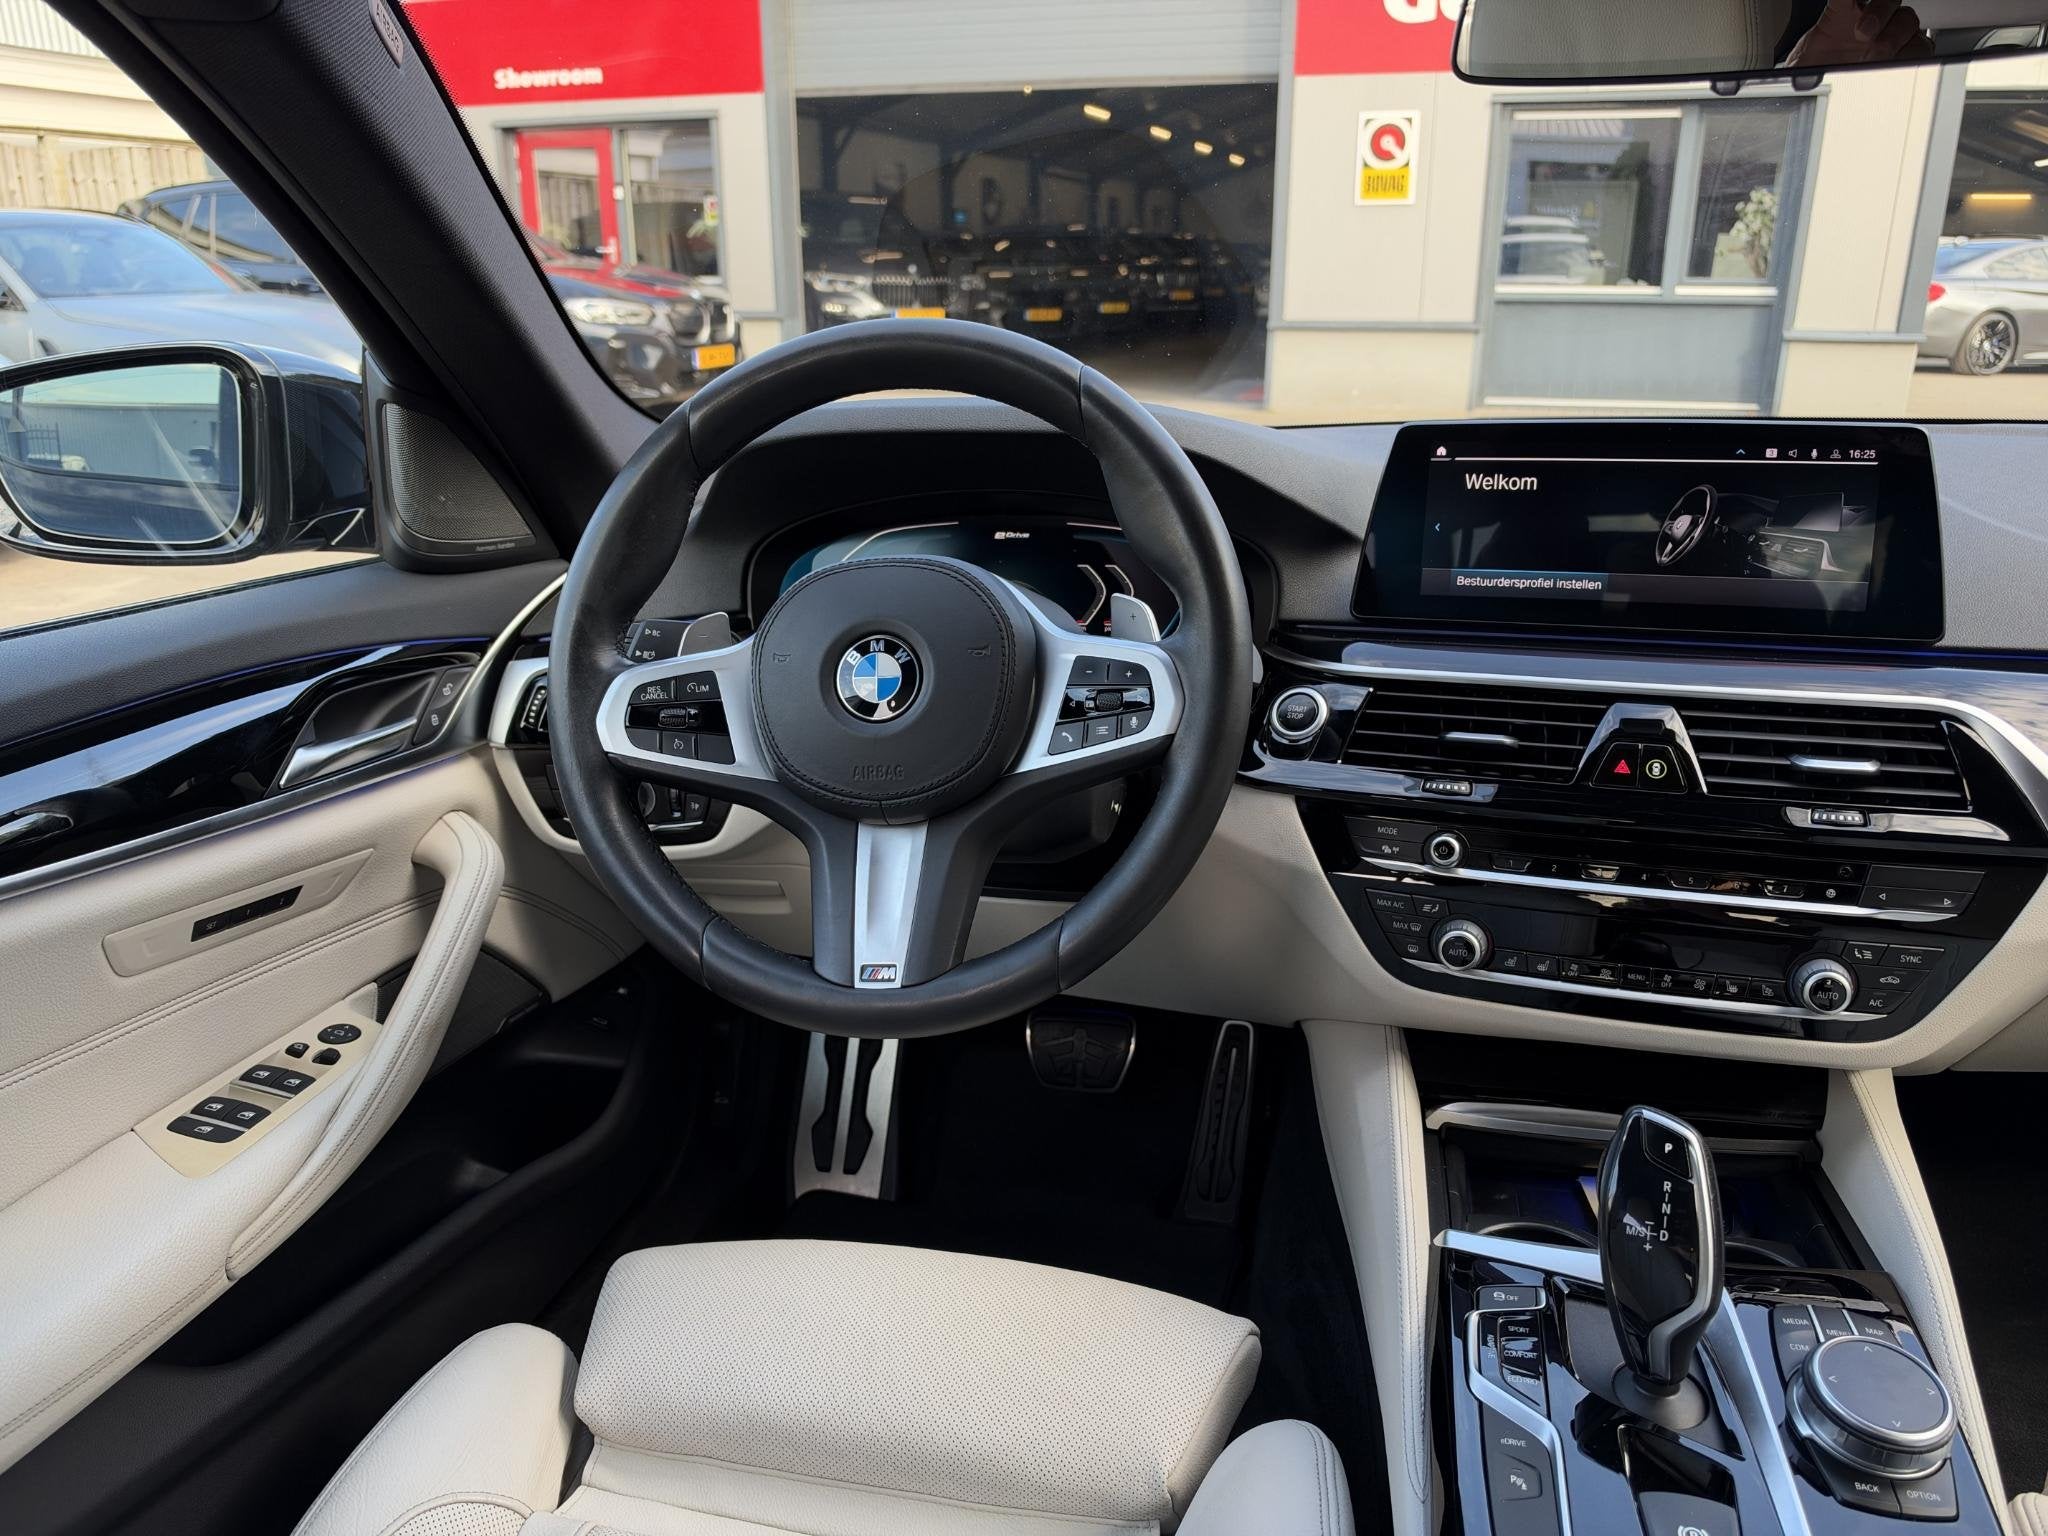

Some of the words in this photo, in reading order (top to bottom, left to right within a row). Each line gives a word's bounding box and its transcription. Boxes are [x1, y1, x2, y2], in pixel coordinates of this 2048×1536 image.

[493, 67, 604, 89] Showroom
[1848, 449, 1876, 459] 16:25
[1465, 473, 1538, 491] Welkom
[1456, 575, 1554, 589] Bestuurdersprofiel
[1556, 578, 1602, 590] instellen
[846, 639, 911, 666] BMW
[647, 685, 661, 694] RES
[695, 685, 709, 693] LIM
[640, 692, 669, 701] CANCEL
[1287, 704, 1307, 713] START
[1286, 712, 1304, 720] STOP
[853, 764, 905, 782] AIRBAG
[1377, 825, 1398, 836] MODE
[1551, 864, 1557, 872] 2
[1640, 873, 1647, 881] 4
[1688, 876, 1694, 885] 5
[1734, 880, 1740, 889] 6
[1377, 898, 1392, 907] MAX
[1393, 899, 1405, 909] A/C
[1393, 920, 1408, 930] MAX
[1447, 948, 1468, 957] AUTO
[1900, 954, 1922, 964] SYNC
[1627, 972, 1645, 981] MENU
[1816, 990, 1839, 1001] AUTO
[1868, 998, 1884, 1008] A/C
[1664, 1142, 1673, 1154] P
[1663, 1180, 1672, 1193] R
[1661, 1203, 1671, 1215] N
[1659, 1230, 1669, 1242] D
[1506, 1294, 1519, 1302] OFF
[1782, 1318, 1809, 1326] MEDIA
[1507, 1325, 1530, 1334] SPORT
[1865, 1327, 1884, 1336] MAP
[1503, 1350, 1538, 1359] COMFORT
[1854, 1482, 1880, 1493] BACK
[1906, 1490, 1941, 1502] OPTION
